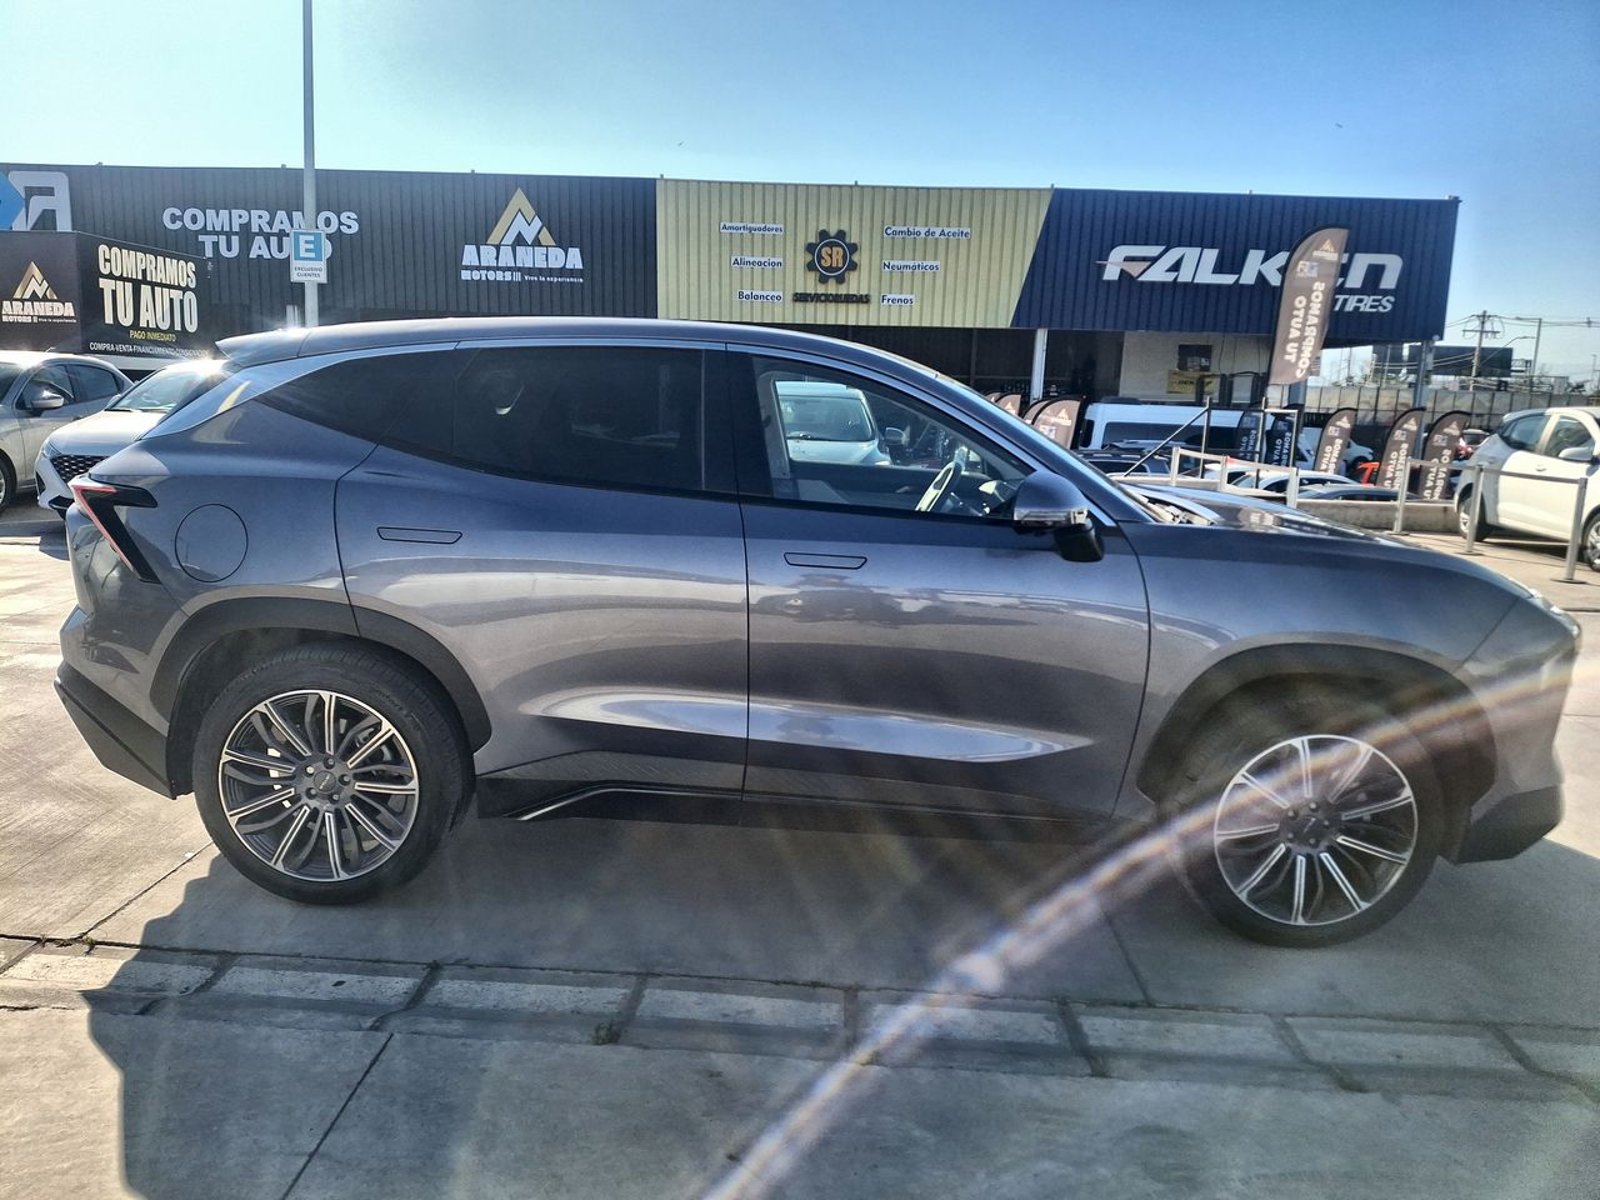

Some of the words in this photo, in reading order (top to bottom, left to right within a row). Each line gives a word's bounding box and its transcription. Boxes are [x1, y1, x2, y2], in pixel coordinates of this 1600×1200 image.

[721, 223, 783, 234] Amortiguadores
[884, 226, 922, 238] Cambio
[924, 228, 937, 238] de
[938, 229, 971, 239] Aceite
[198, 235, 240, 259] TU
[249, 236, 333, 259] AU
[299, 235, 316, 258] E
[461, 244, 584, 270] ARANEDA
[732, 257, 783, 268] Alineacion
[820, 246, 844, 268] SR
[98, 244, 197, 289] COMPRAMOS
[460, 269, 512, 281] MOTORS
[1096, 244, 1404, 290] FALKN
[738, 290, 783, 302] Balanceo
[881, 294, 914, 305] Frenos
[1333, 295, 1396, 313] TIRES
[1, 300, 75, 317] ARANEDA
[99, 278, 134, 327] TU
[139, 284, 199, 333] AUTO
[129, 329, 146, 340] PAGO
